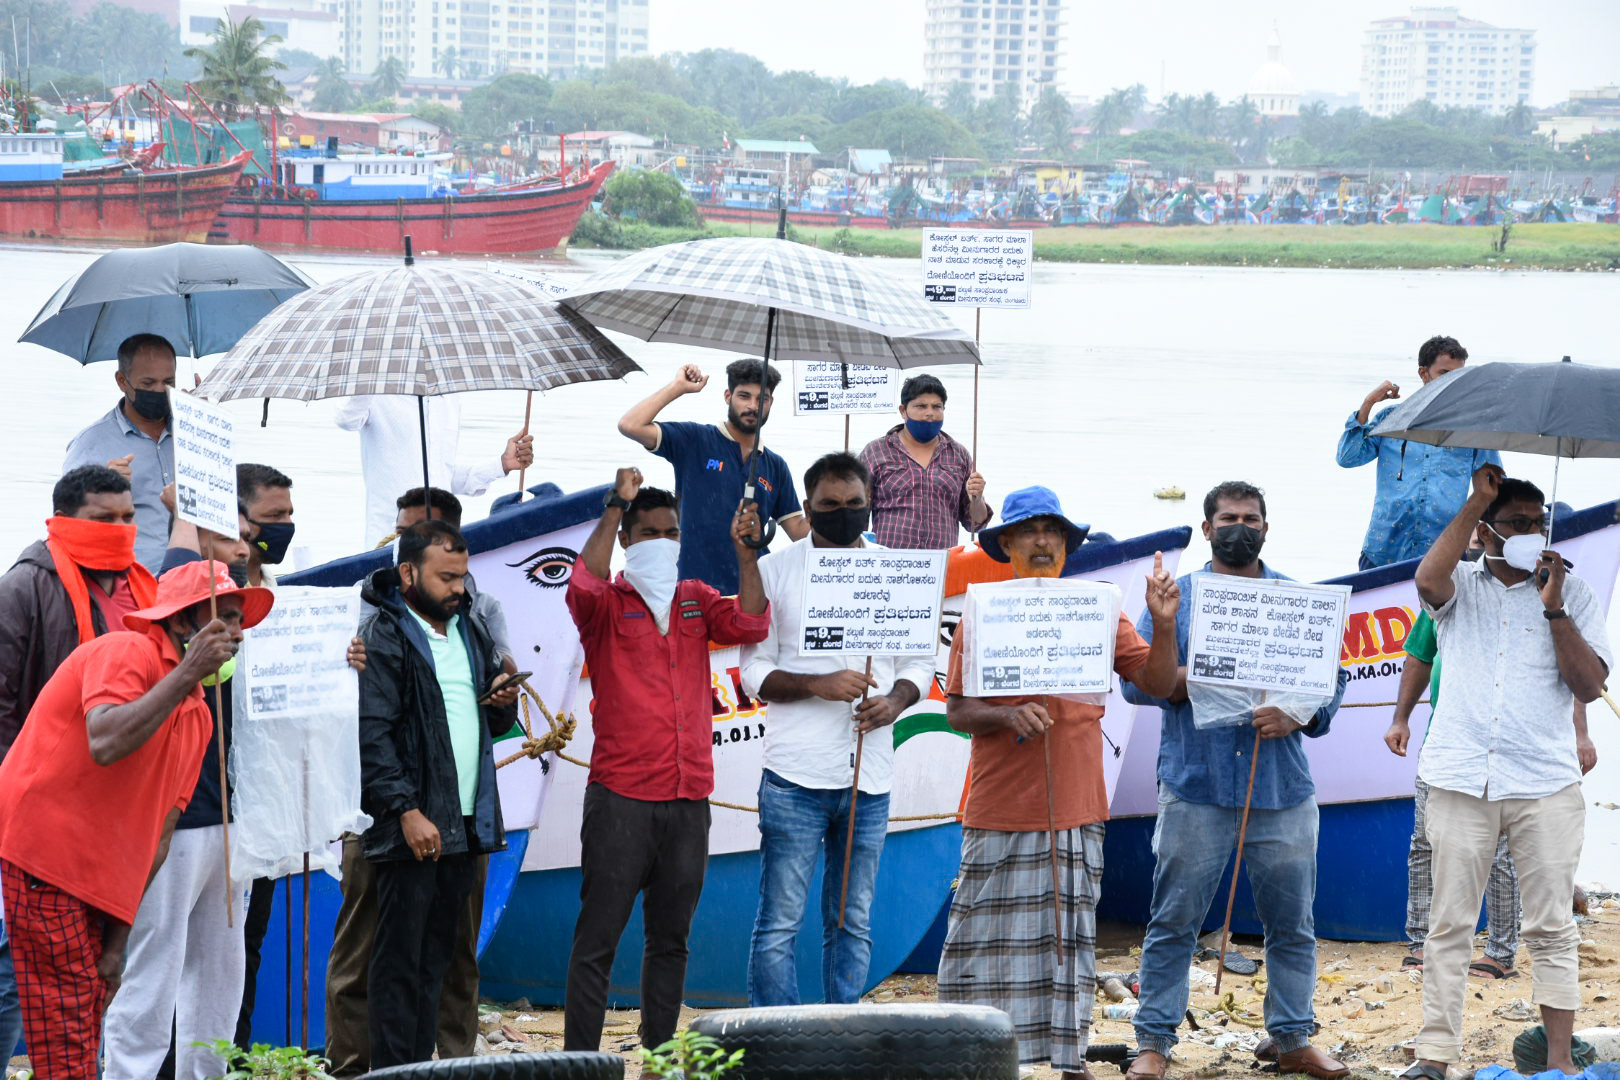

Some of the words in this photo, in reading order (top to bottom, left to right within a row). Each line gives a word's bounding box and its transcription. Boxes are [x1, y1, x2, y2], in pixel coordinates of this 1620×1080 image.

[979, 271, 1024, 283] ಪ್ರತಿಭಟನೆ
[819, 556, 852, 572] ಕೋಸ್ಟಲ್
[880, 558, 931, 570] ಸಾಂಪ್ರದಾಯಿಕ
[811, 574, 855, 583] ಮೀನುಗಾರರ
[858, 575, 882, 584] ಬದುಕು
[1202, 589, 1258, 603] ಸಾಂಪ್ರದಾಯಿಕ
[1261, 594, 1309, 608] ಮೀನುಗಾರರ
[874, 605, 931, 624] ಪ್ರತಿಭಟನೆ
[1231, 607, 1258, 618] ಶಾಸನ
[1210, 621, 1238, 633] ಸಾಗರ
[1242, 623, 1269, 636] ಮಾಲಾ
